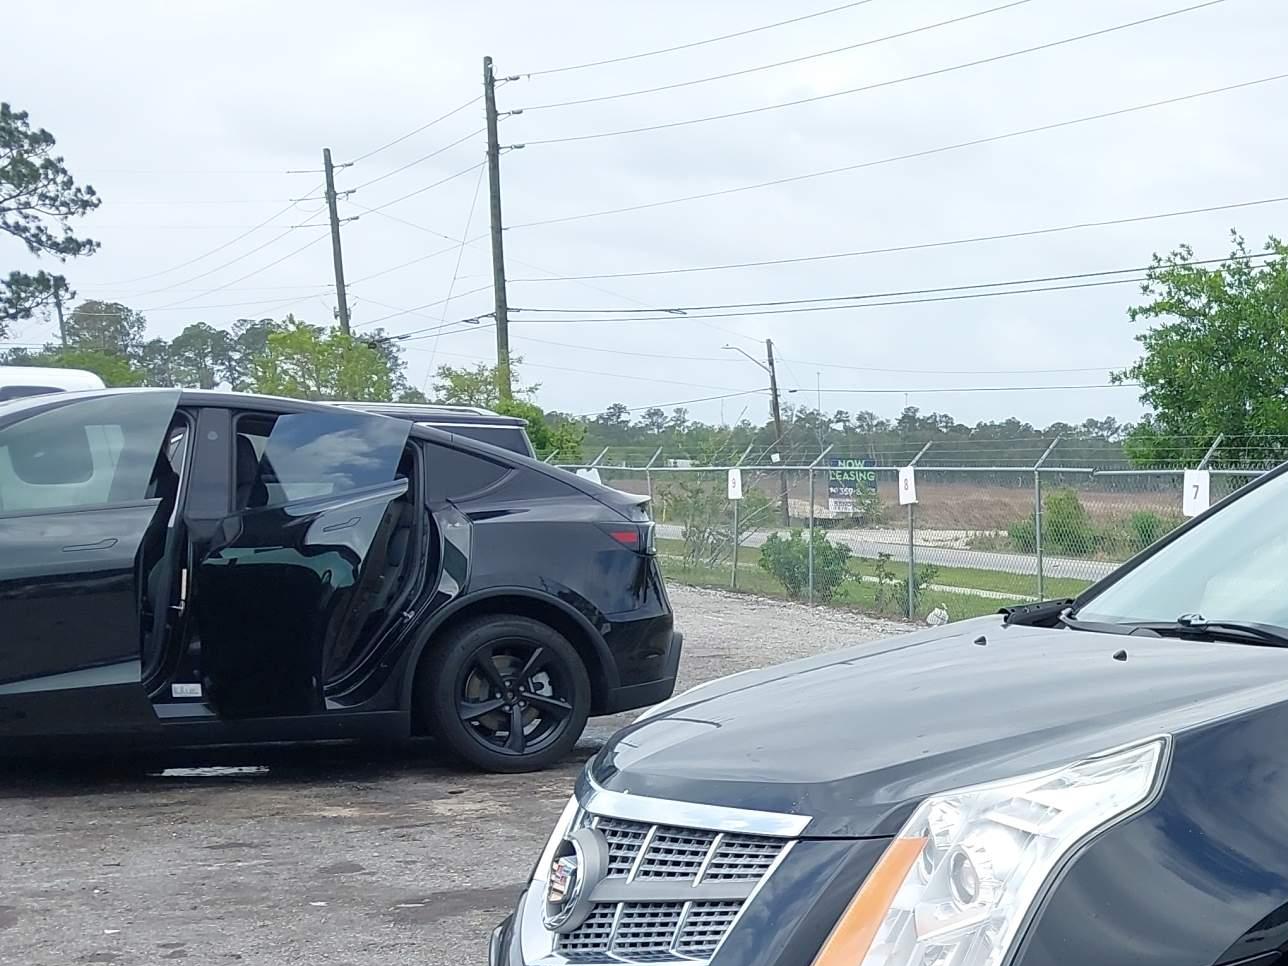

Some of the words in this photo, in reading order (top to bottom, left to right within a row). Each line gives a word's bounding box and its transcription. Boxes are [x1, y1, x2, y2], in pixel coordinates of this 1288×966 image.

[838, 460, 865, 469] NOW
[830, 471, 876, 480] LEASING
[1192, 484, 1200, 500] 7
